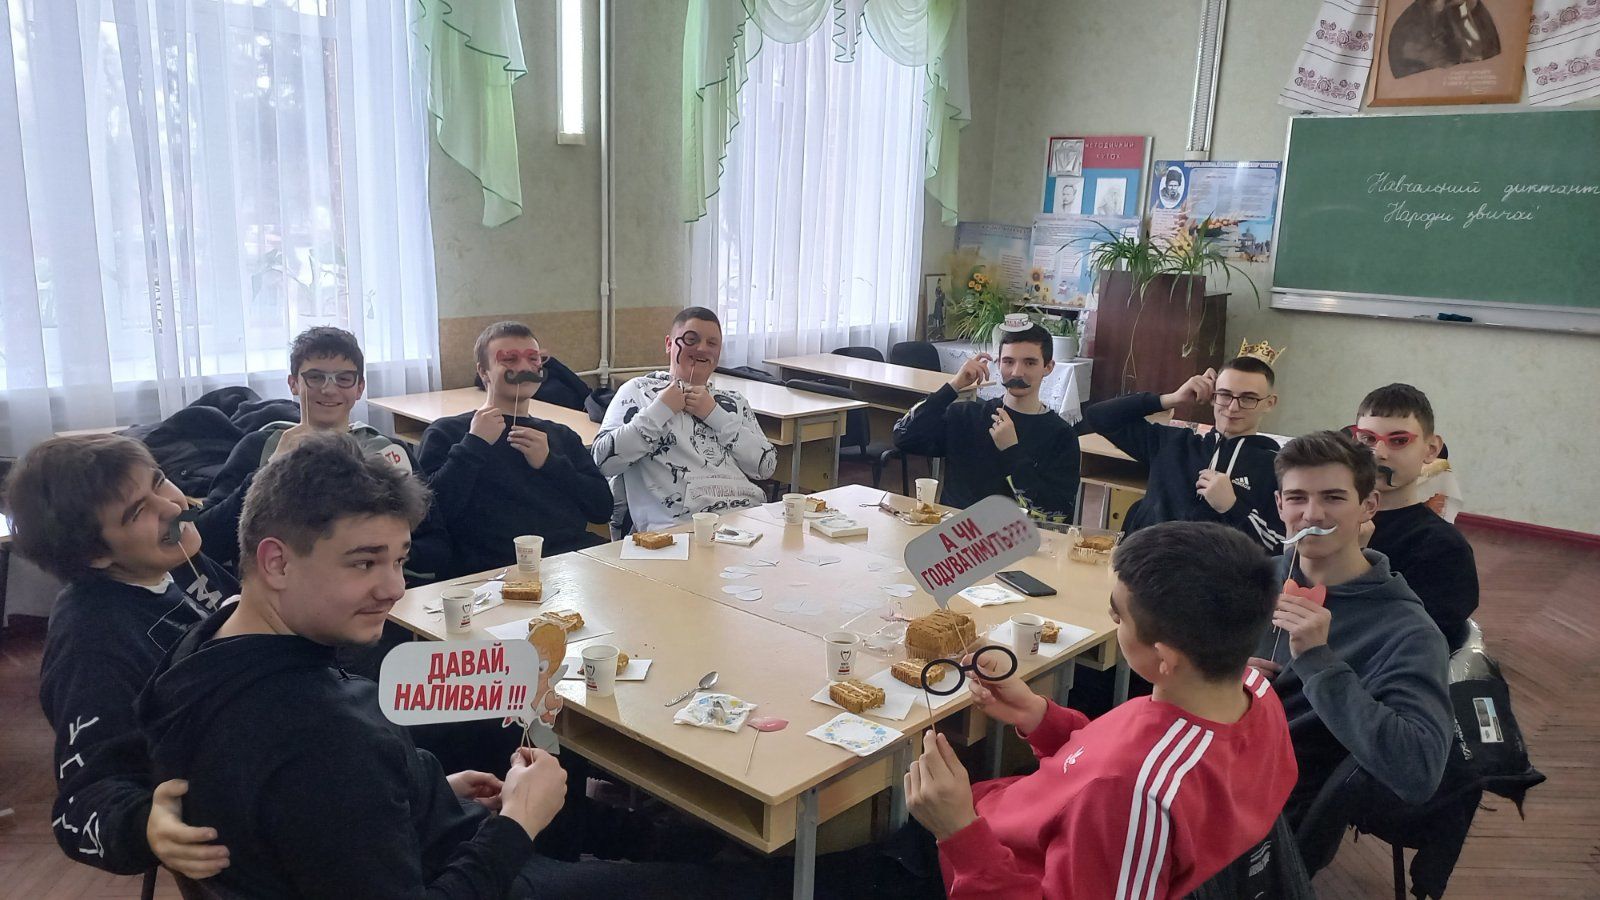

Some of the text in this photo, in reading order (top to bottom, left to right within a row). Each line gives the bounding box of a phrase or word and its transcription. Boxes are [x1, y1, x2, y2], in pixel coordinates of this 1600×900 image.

[1366, 171, 1481, 194] Навчальний
[1383, 200, 1540, 230] Народні звичаї
[938, 517, 983, 553] А ЧИ
[427, 642, 510, 684] ДАВАЙ,
[394, 680, 527, 711] НАЛИВАЙ !!!
